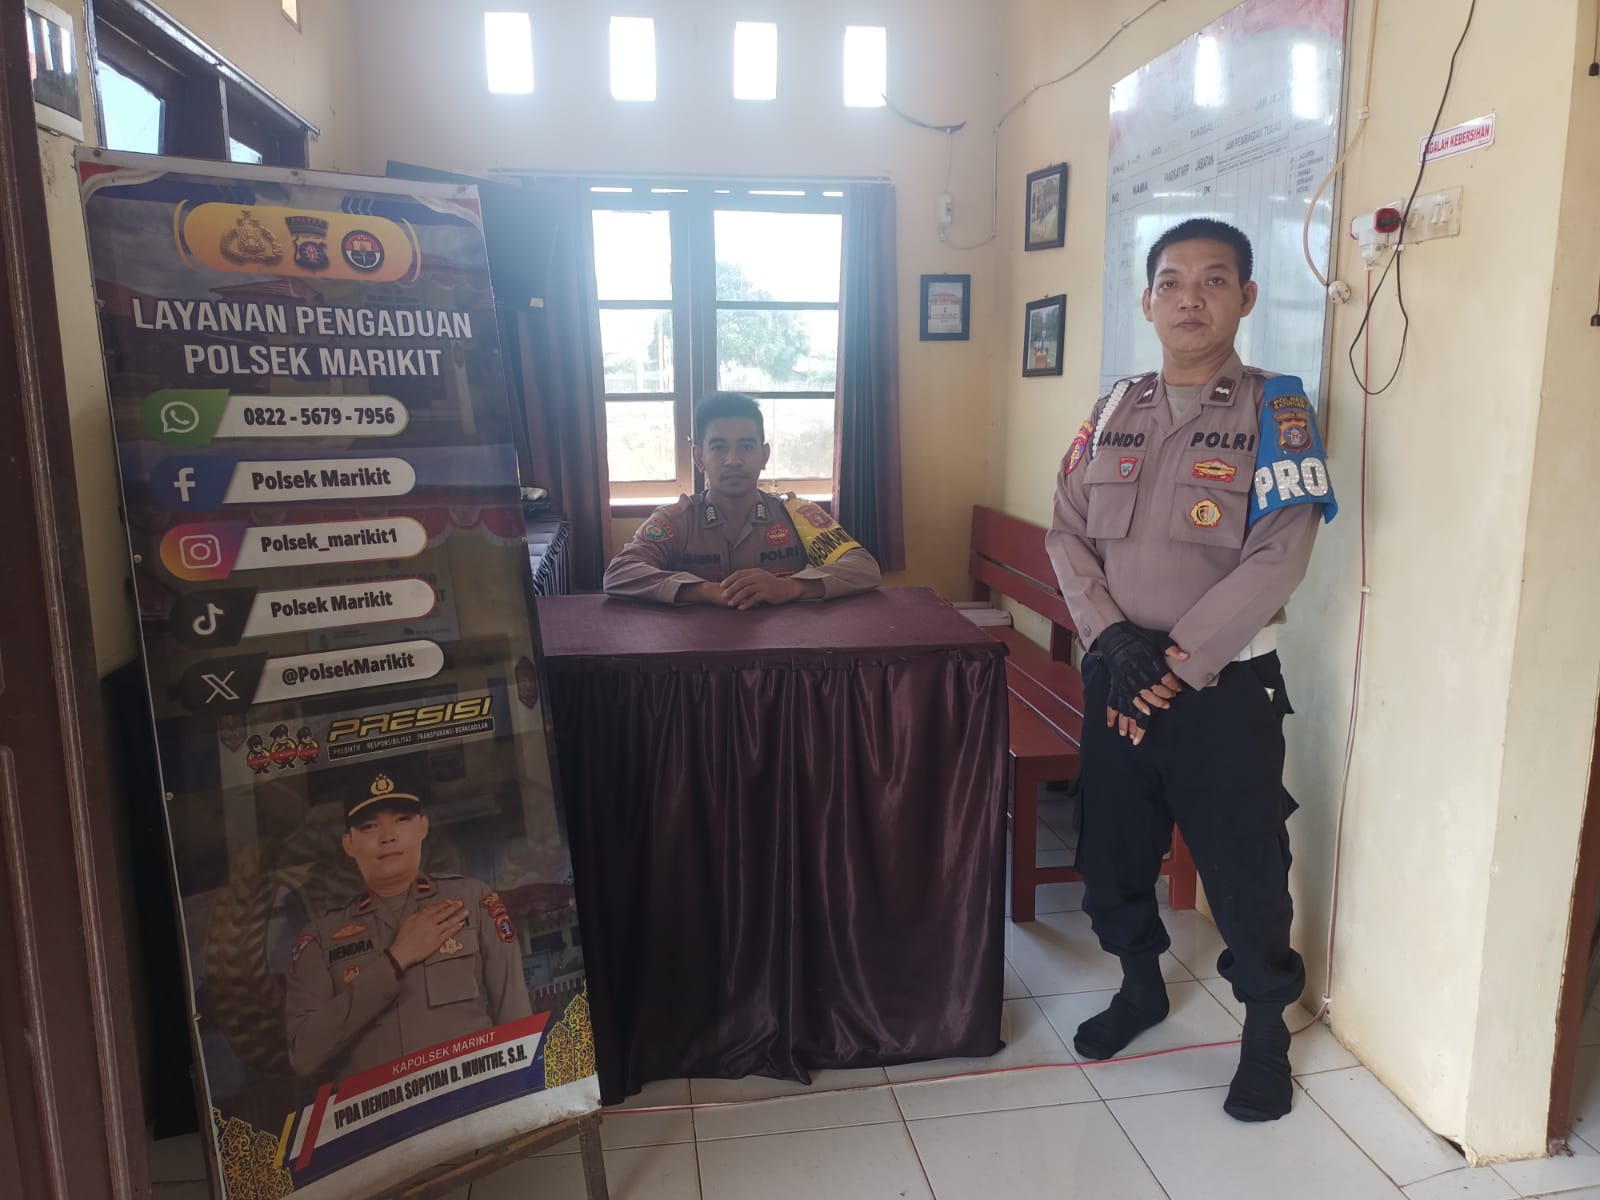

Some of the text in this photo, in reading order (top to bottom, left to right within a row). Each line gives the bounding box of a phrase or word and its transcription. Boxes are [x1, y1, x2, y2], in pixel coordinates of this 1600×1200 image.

[1450, 123, 1490, 147] KEBERSIHAN
[132, 298, 473, 338] LAYANAN PENGADUAN
[184, 344, 442, 376] POLSEK MARIKIT
[243, 407, 287, 426] 0822
[301, 407, 342, 426] 5679
[354, 406, 395, 424] 7956
[1098, 431, 1145, 448] ANDO
[1190, 431, 1255, 451] POLRI
[252, 467, 391, 490] Polsek Marikit
[1255, 457, 1328, 510] PRO
[261, 528, 398, 552] Polsek_marikit1
[760, 546, 799, 562] POLRI
[271, 590, 393, 618] Polsek Marikit
[282, 652, 415, 685] @PolsekMarikit
[329, 697, 492, 742] PRESISI
[328, 939, 374, 961] HENDRA
[392, 1031, 496, 1076] KAPOLSEK MARIKIT
[334, 1044, 528, 1130] IPDA HENDRA SOPIYAN D. MUNTHE, S.H.
